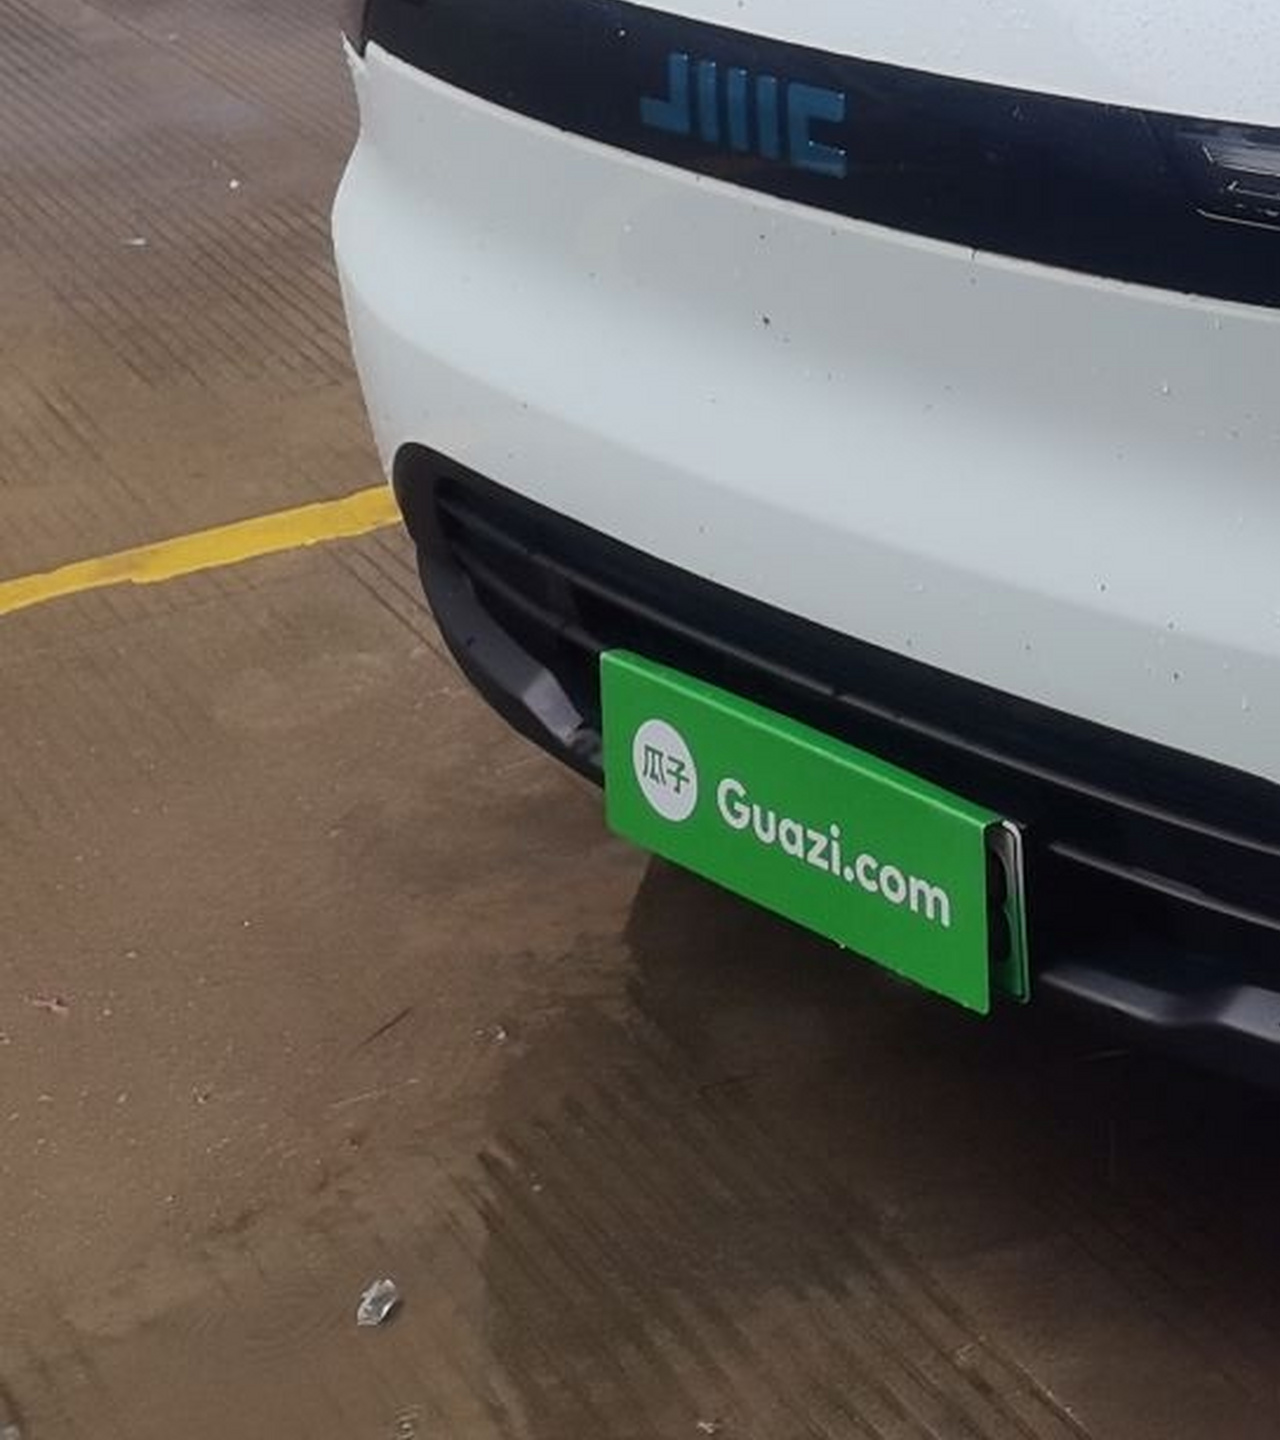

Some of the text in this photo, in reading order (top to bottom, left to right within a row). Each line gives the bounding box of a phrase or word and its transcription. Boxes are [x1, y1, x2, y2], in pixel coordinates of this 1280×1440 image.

[640, 51, 848, 180] JMC
[642, 744, 690, 794] 瓜子
[716, 777, 951, 928] Guazi.com
